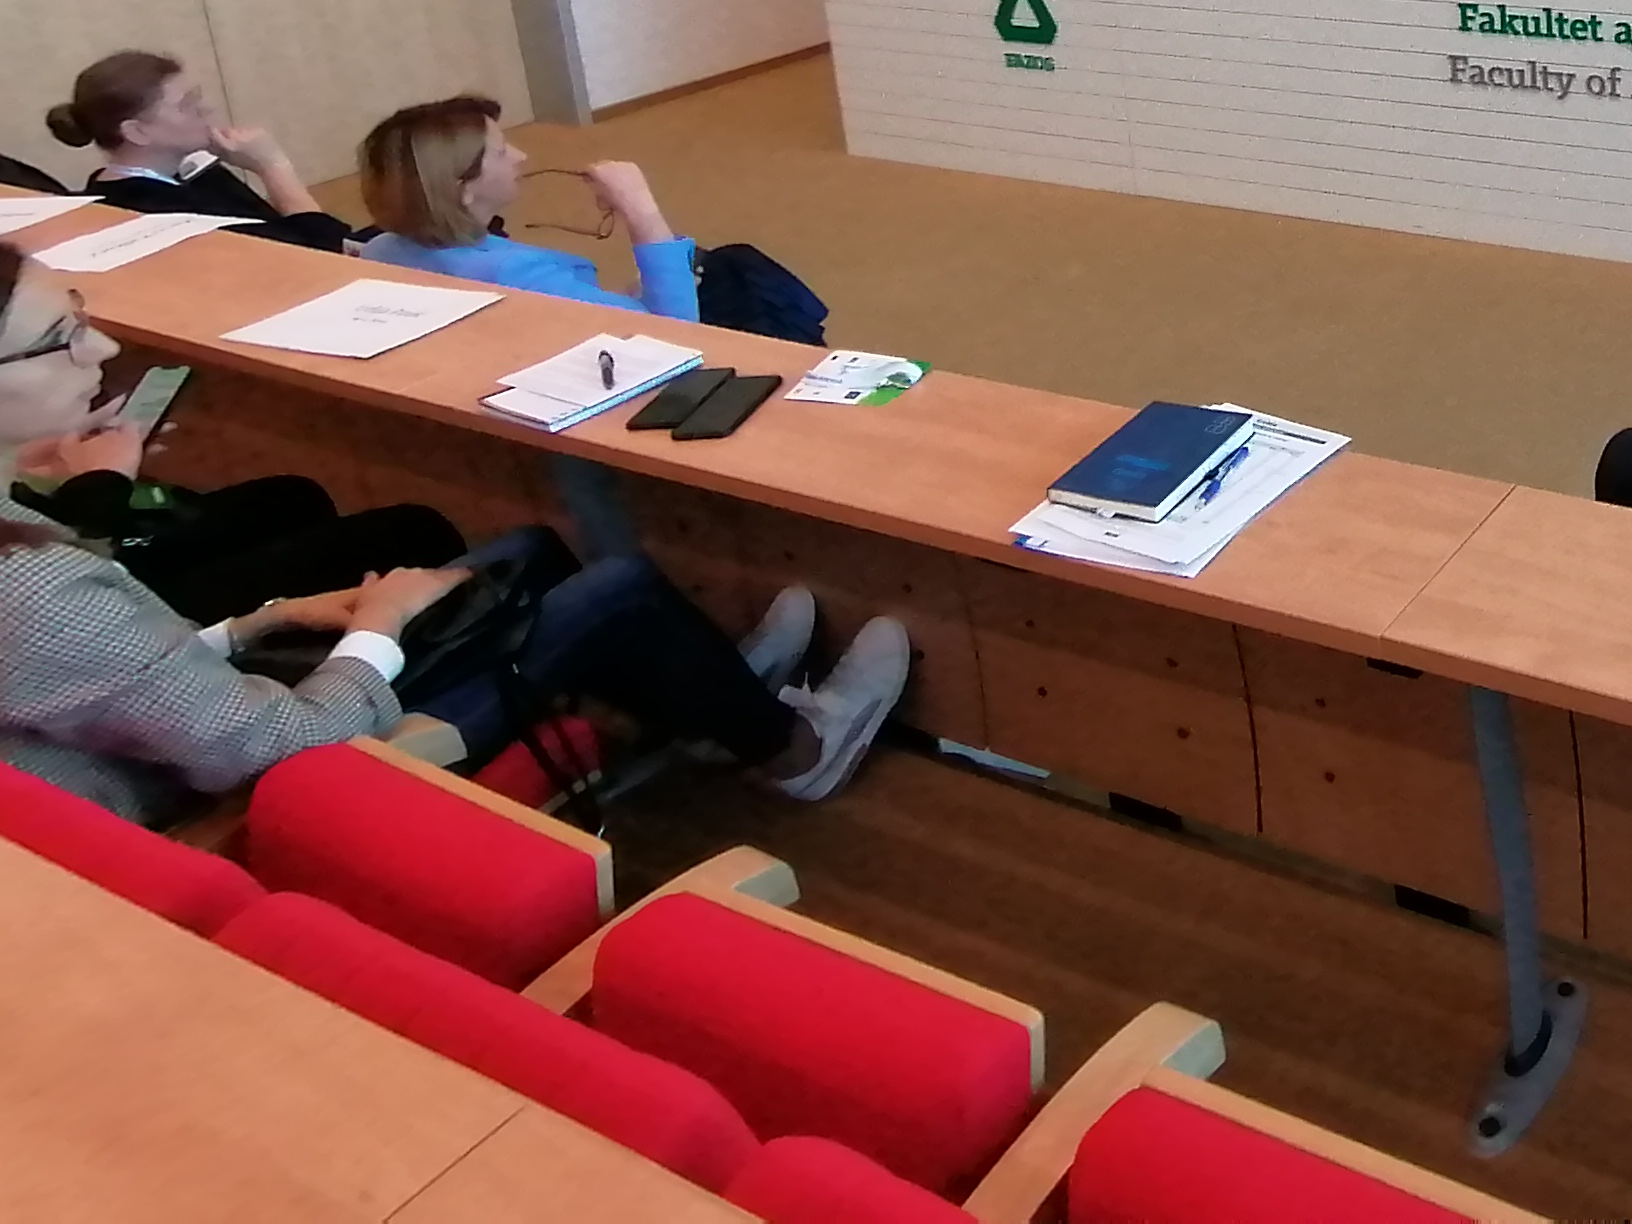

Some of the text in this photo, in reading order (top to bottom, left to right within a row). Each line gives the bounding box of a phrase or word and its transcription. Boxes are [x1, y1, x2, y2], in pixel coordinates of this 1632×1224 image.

[1458, 2, 1604, 43] Fakultet
[1447, 55, 1577, 101] Faculty
[1585, 67, 1623, 98] of
